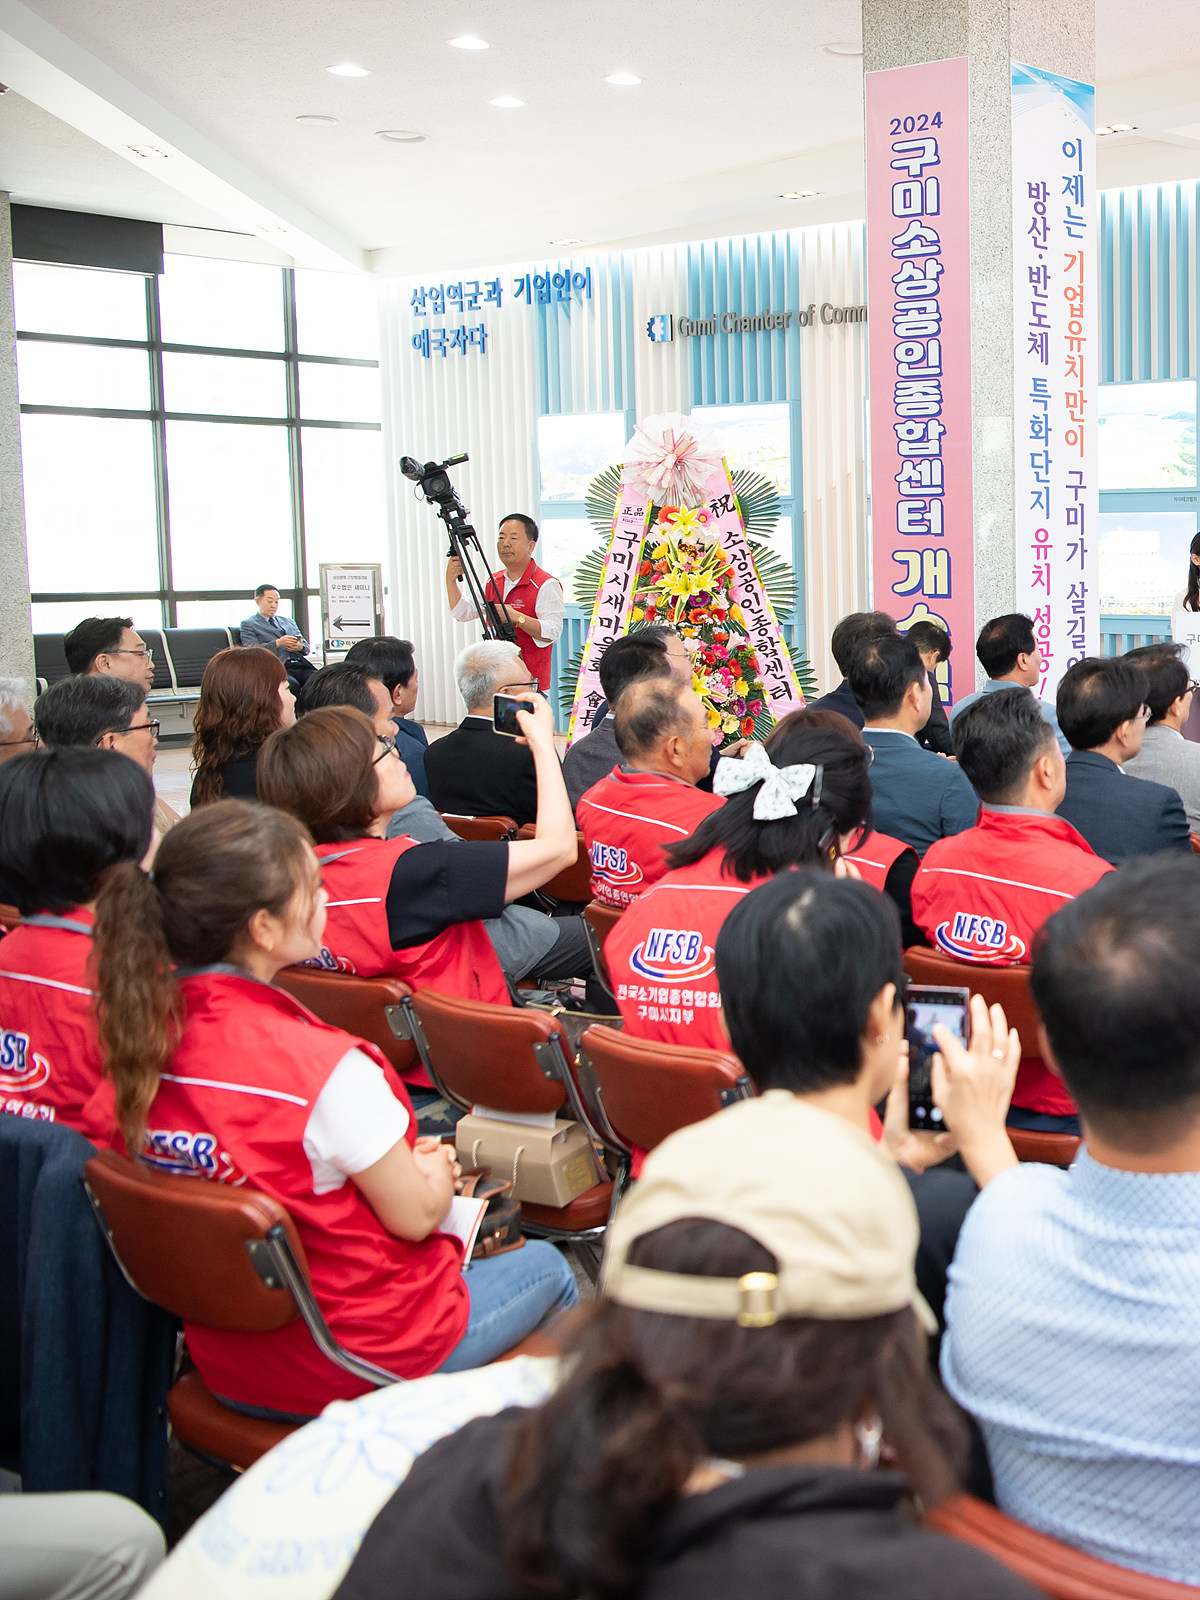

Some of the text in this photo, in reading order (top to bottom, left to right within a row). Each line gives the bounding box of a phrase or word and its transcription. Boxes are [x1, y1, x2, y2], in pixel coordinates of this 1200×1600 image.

[889, 112, 943, 136] 2024
[1061, 138, 1087, 239] 이제는
[410, 267, 592, 317] 산업역군과 기업인이
[1027, 181, 1051, 366] 방산·반도체
[411, 323, 488, 359] 애국자다
[678, 313, 716, 338] Gumi
[720, 308, 792, 334] Chamber
[797, 304, 816, 327] of
[890, 137, 946, 536] 구미소상공인종합센터
[1063, 251, 1088, 458] 기업유치만이
[1029, 377, 1052, 520] 특화단지
[1065, 470, 1088, 570] 구미가
[1031, 528, 1053, 596] 유치
[710, 494, 793, 702] 祝 소상공인종합센터
[592, 840, 628, 874] NFSB
[643, 928, 703, 965] NFSB
[951, 911, 1007, 948] NFSB
[0, 1028, 30, 1073] SB
